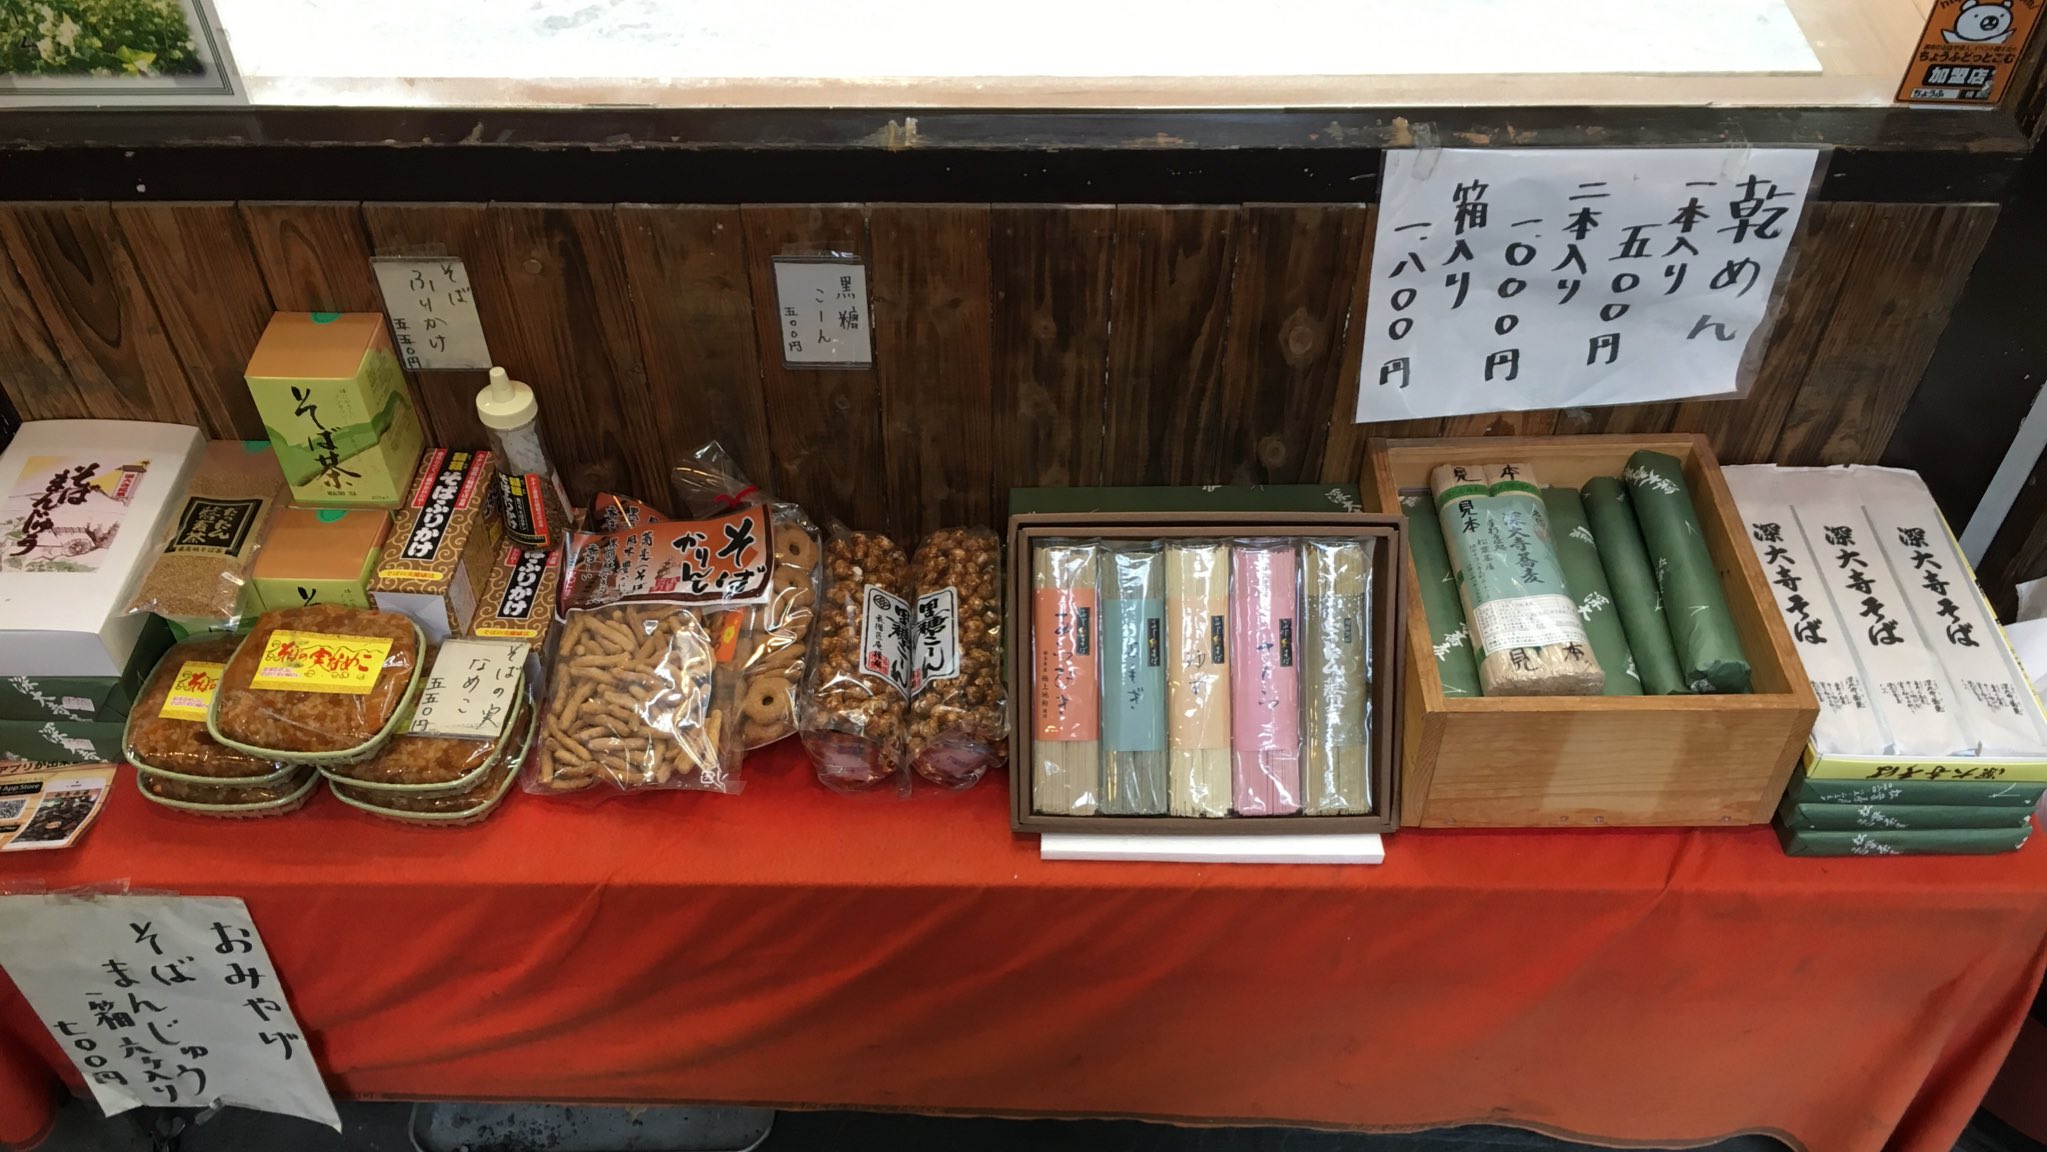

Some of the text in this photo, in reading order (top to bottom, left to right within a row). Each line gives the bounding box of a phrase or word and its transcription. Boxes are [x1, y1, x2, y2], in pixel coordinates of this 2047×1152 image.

[1928, 67, 1990, 85] 加盟店
[441, 264, 470, 306] そば
[1441, 179, 1489, 310] 箱入り
[1551, 181, 1611, 305] 二本入り
[1662, 181, 1718, 296] 一本入り
[1687, 174, 1796, 342] 乾めん
[410, 269, 448, 353] ふりかけ
[816, 288, 831, 344] こーん
[836, 275, 859, 330] 黒糖
[290, 386, 362, 489] そば茶
[407, 471, 462, 557] そばふりかけ
[1458, 499, 1481, 534] 見本
[1752, 523, 1828, 646] 深大寺そば
[1823, 525, 1905, 647] 深大寺そば
[1897, 526, 1981, 648] 深大寺そば
[458, 658, 491, 714] なめこ
[476, 643, 524, 730] そばの実
[129, 922, 196, 986] そば
[210, 922, 299, 1060] おみやげ
[102, 959, 209, 1096] まんじゅう
